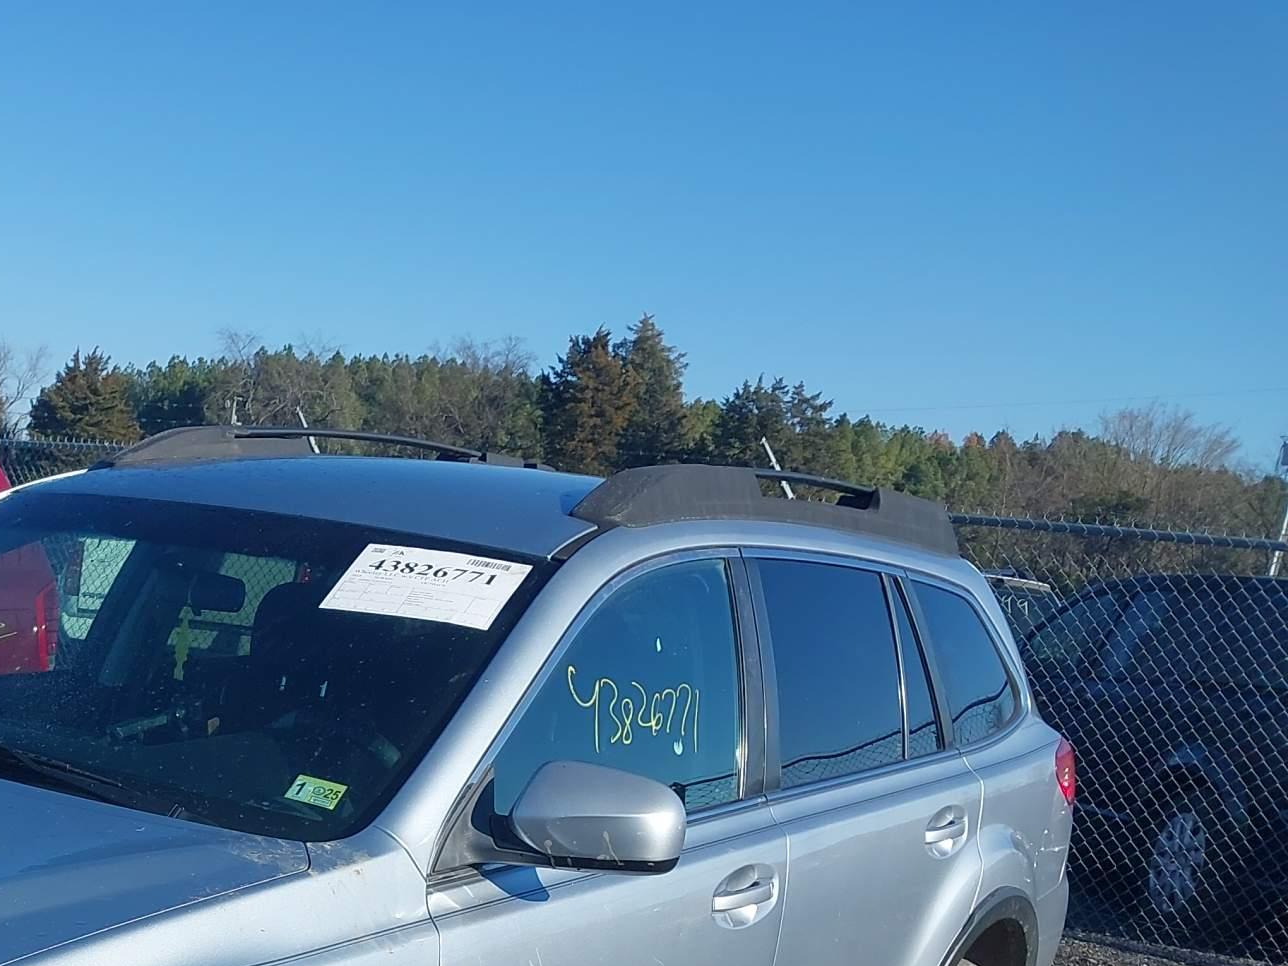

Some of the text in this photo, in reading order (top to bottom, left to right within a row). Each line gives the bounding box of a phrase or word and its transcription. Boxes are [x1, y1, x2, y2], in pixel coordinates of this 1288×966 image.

[368, 559, 498, 586] 43826771
[567, 665, 700, 753] 43826771
[296, 781, 342, 801] 1 25
